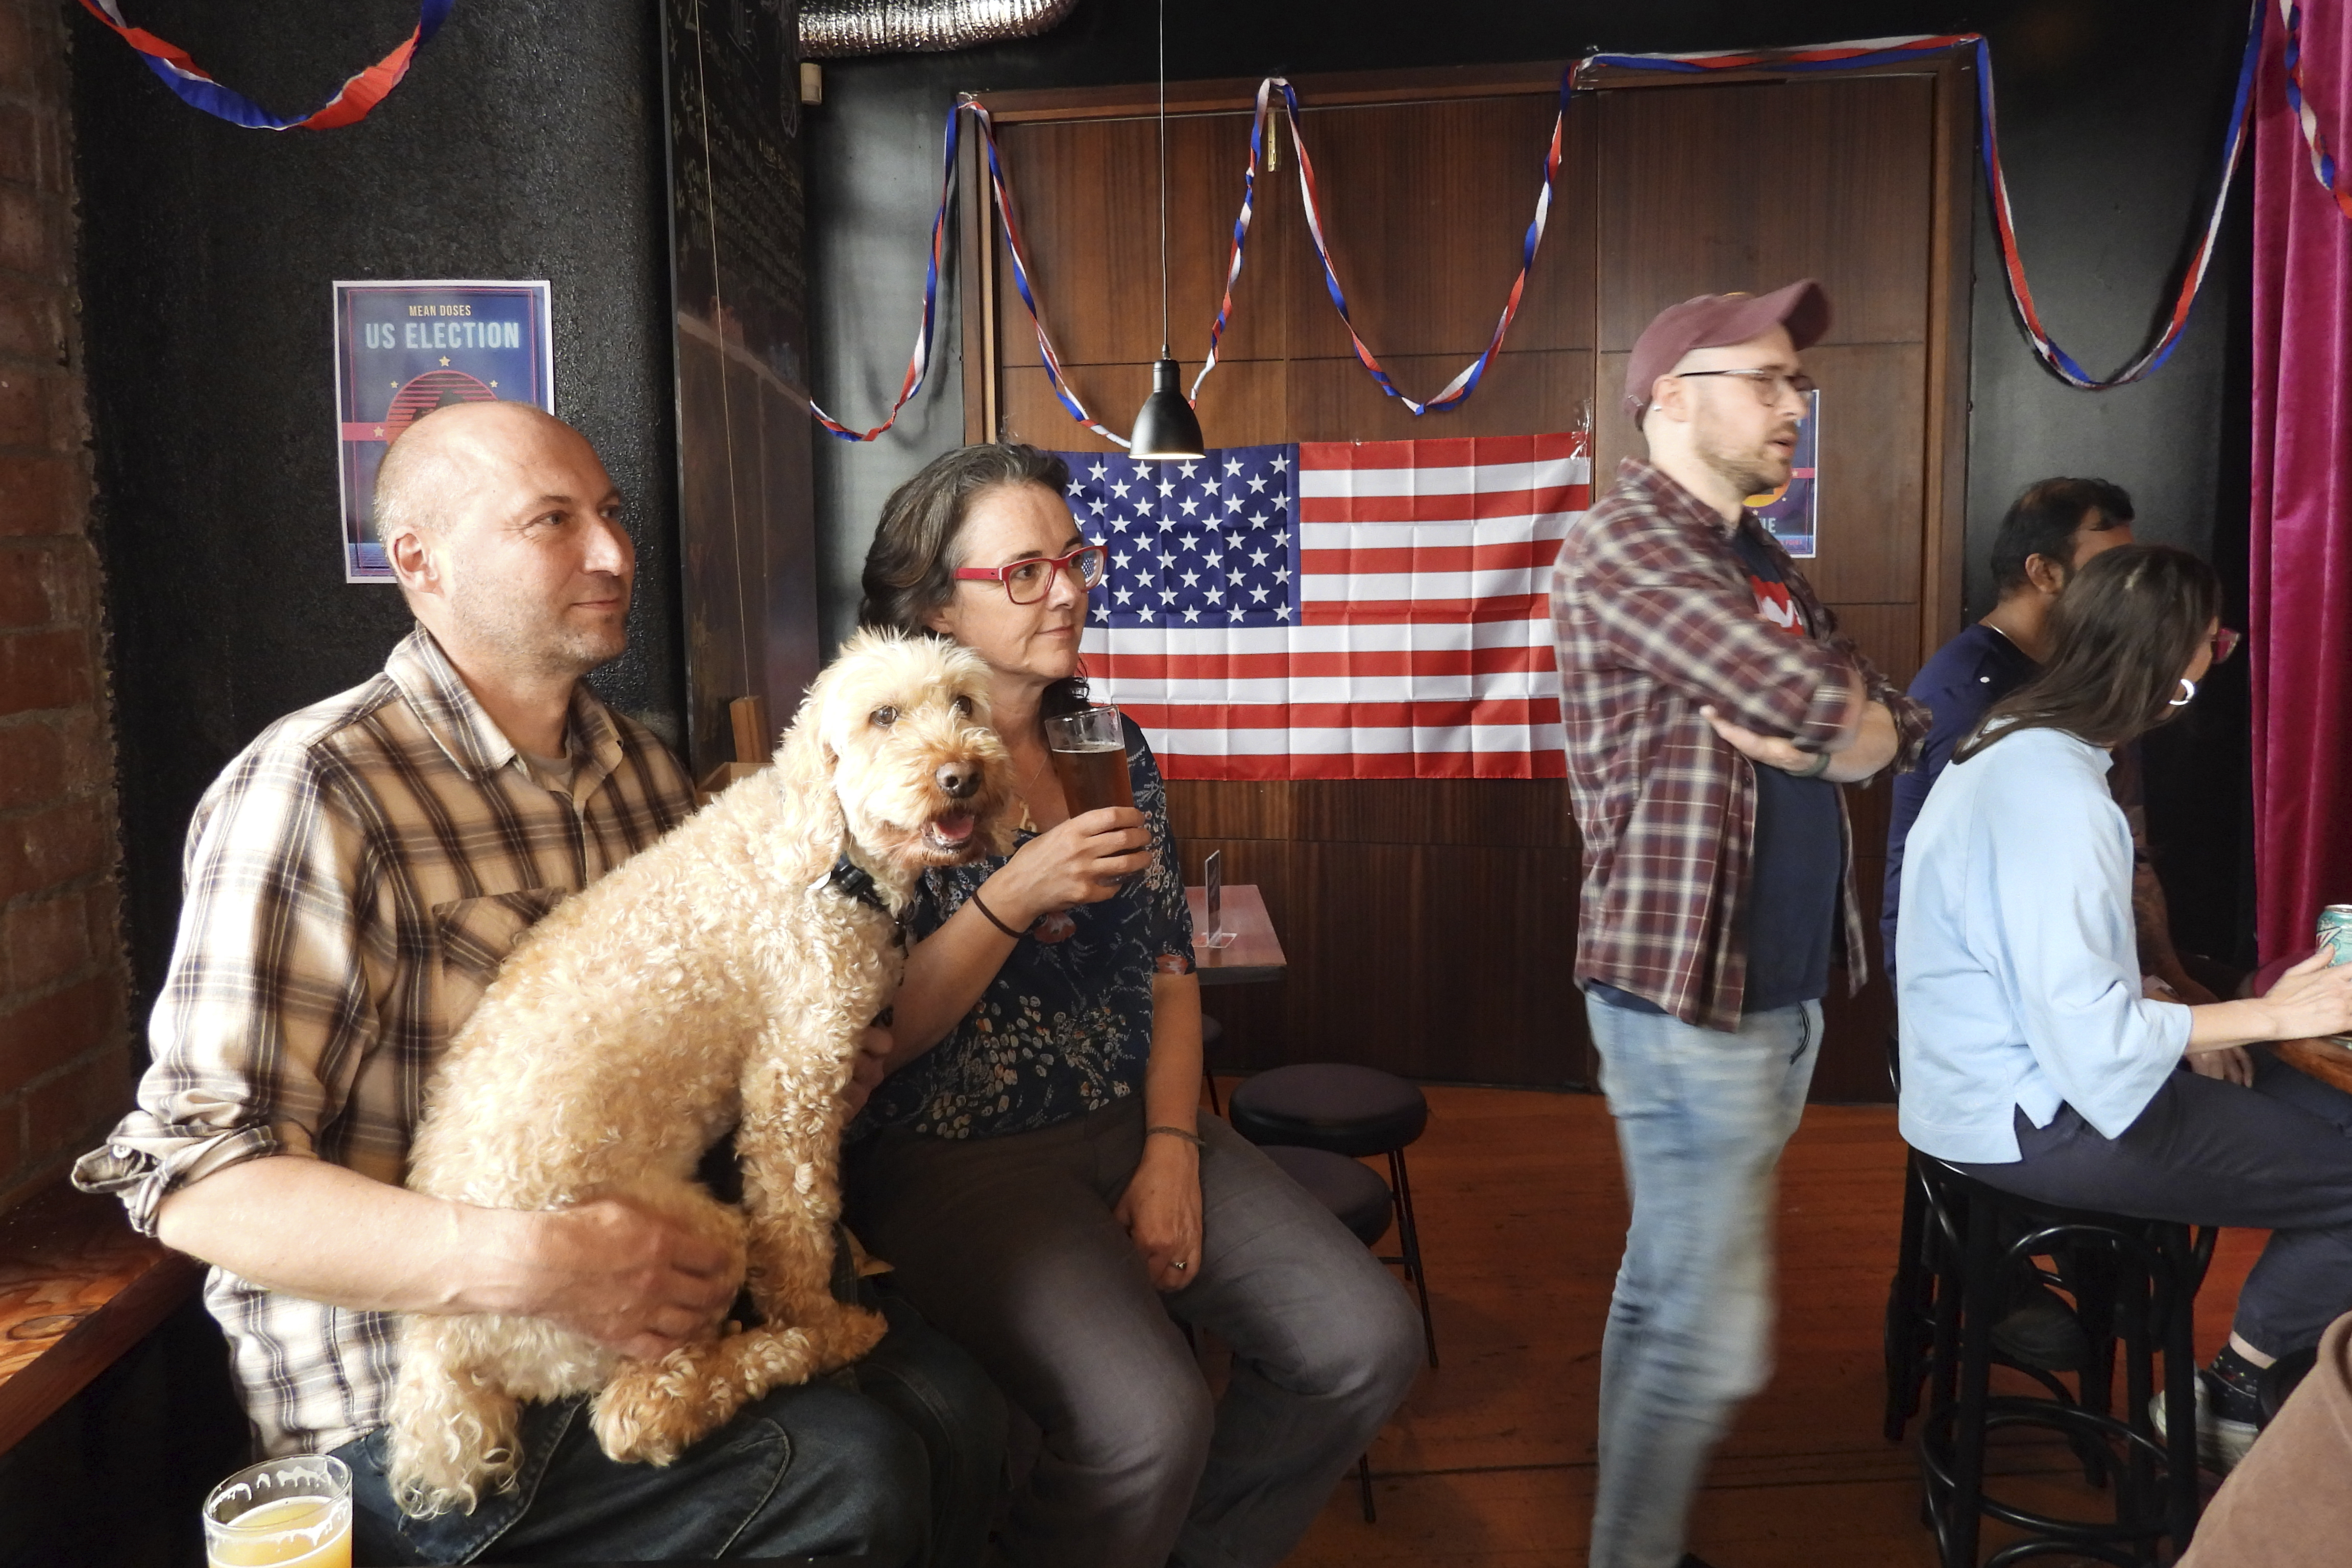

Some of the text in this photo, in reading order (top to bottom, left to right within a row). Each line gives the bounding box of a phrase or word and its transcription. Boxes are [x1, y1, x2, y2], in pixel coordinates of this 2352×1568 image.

[409, 305, 472, 316] MEAN DOSES
[365, 322, 519, 349] US ELECTION
